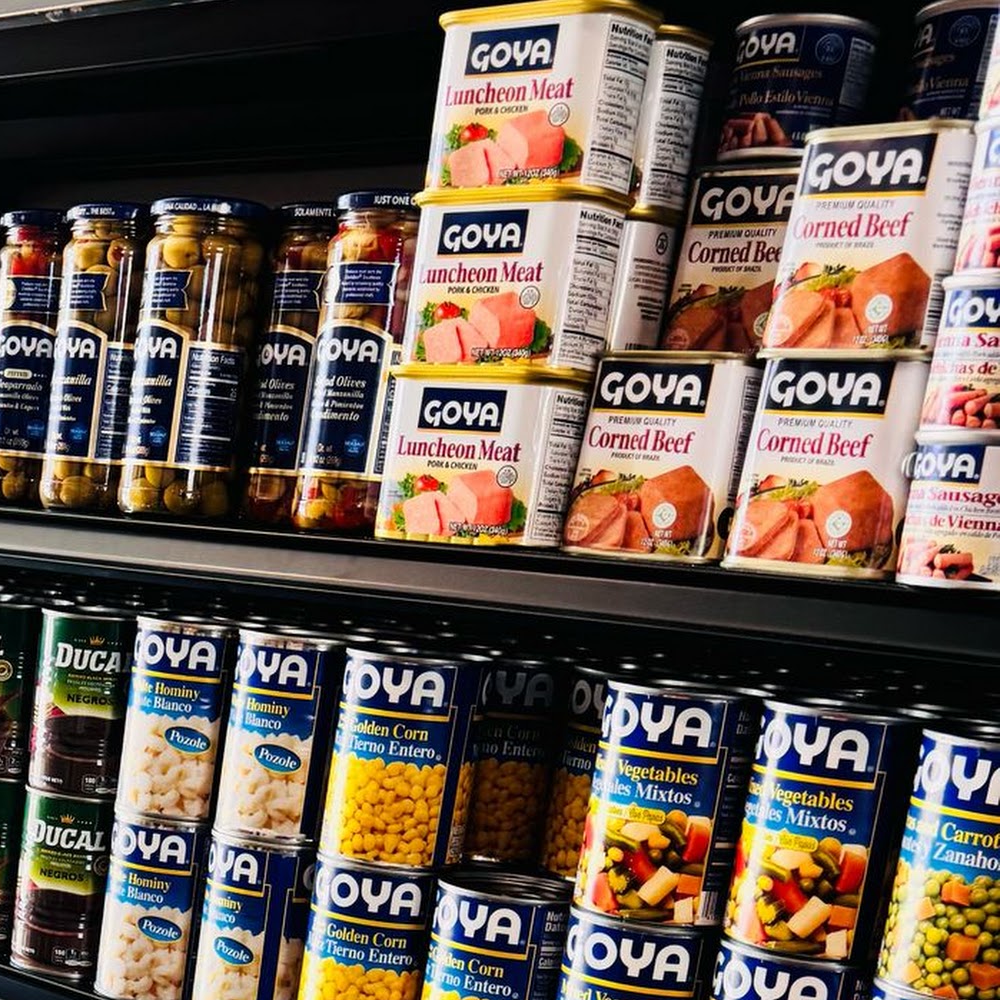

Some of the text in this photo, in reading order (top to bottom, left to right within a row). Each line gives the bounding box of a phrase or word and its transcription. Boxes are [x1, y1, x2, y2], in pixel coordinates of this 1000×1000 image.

[471, 38, 550, 72] GOYA
[445, 77, 574, 107] Luncheon Meat
[475, 104, 528, 115] PORK CHICKEN
[807, 148, 922, 190] GOYA
[390, 196, 409, 205] ONE
[709, 228, 776, 239] PREMIUM QUALITY
[793, 211, 914, 239] Corned Beef
[444, 222, 520, 251] GOYA
[688, 240, 753, 265] Corned
[506, 261, 543, 283] Meat
[448, 285, 499, 294] PORK CHICKEN
[336, 374, 367, 389] Olives
[600, 371, 701, 406] GOYA
[768, 370, 881, 408] GOYA
[424, 400, 498, 426] GOYA
[608, 417, 677, 426] PREMIUM QUALITY
[777, 417, 815, 427] PREMIUM
[398, 435, 520, 462] Luncheon Meat
[588, 425, 696, 454] Corned Beef
[758, 428, 874, 458] Corned Beef
[428, 460, 477, 470] PORK CHICKEN
[155, 682, 200, 699] Hominy
[153, 696, 192, 713] Blanco
[247, 697, 289, 718] Hominy
[245, 715, 282, 730] Blanco
[392, 724, 429, 741] Corn
[169, 729, 207, 751] Pozole
[388, 741, 436, 759] Entero
[258, 747, 298, 769] Pozole
[618, 760, 698, 786] Vegetables
[635, 782, 692, 805] Mixtos
[769, 787, 854, 811] Vegetables
[785, 810, 847, 832] Mixtos
[128, 873, 171, 893] Hominy
[127, 886, 164, 904] Blanco
[141, 920, 179, 940] Pozole
[327, 923, 407, 949] Golden Corn
[216, 940, 250, 963] Pozole
[326, 942, 413, 966] Tierno Entero
[468, 956, 504, 978] Corn
[463, 974, 512, 997] Entero
